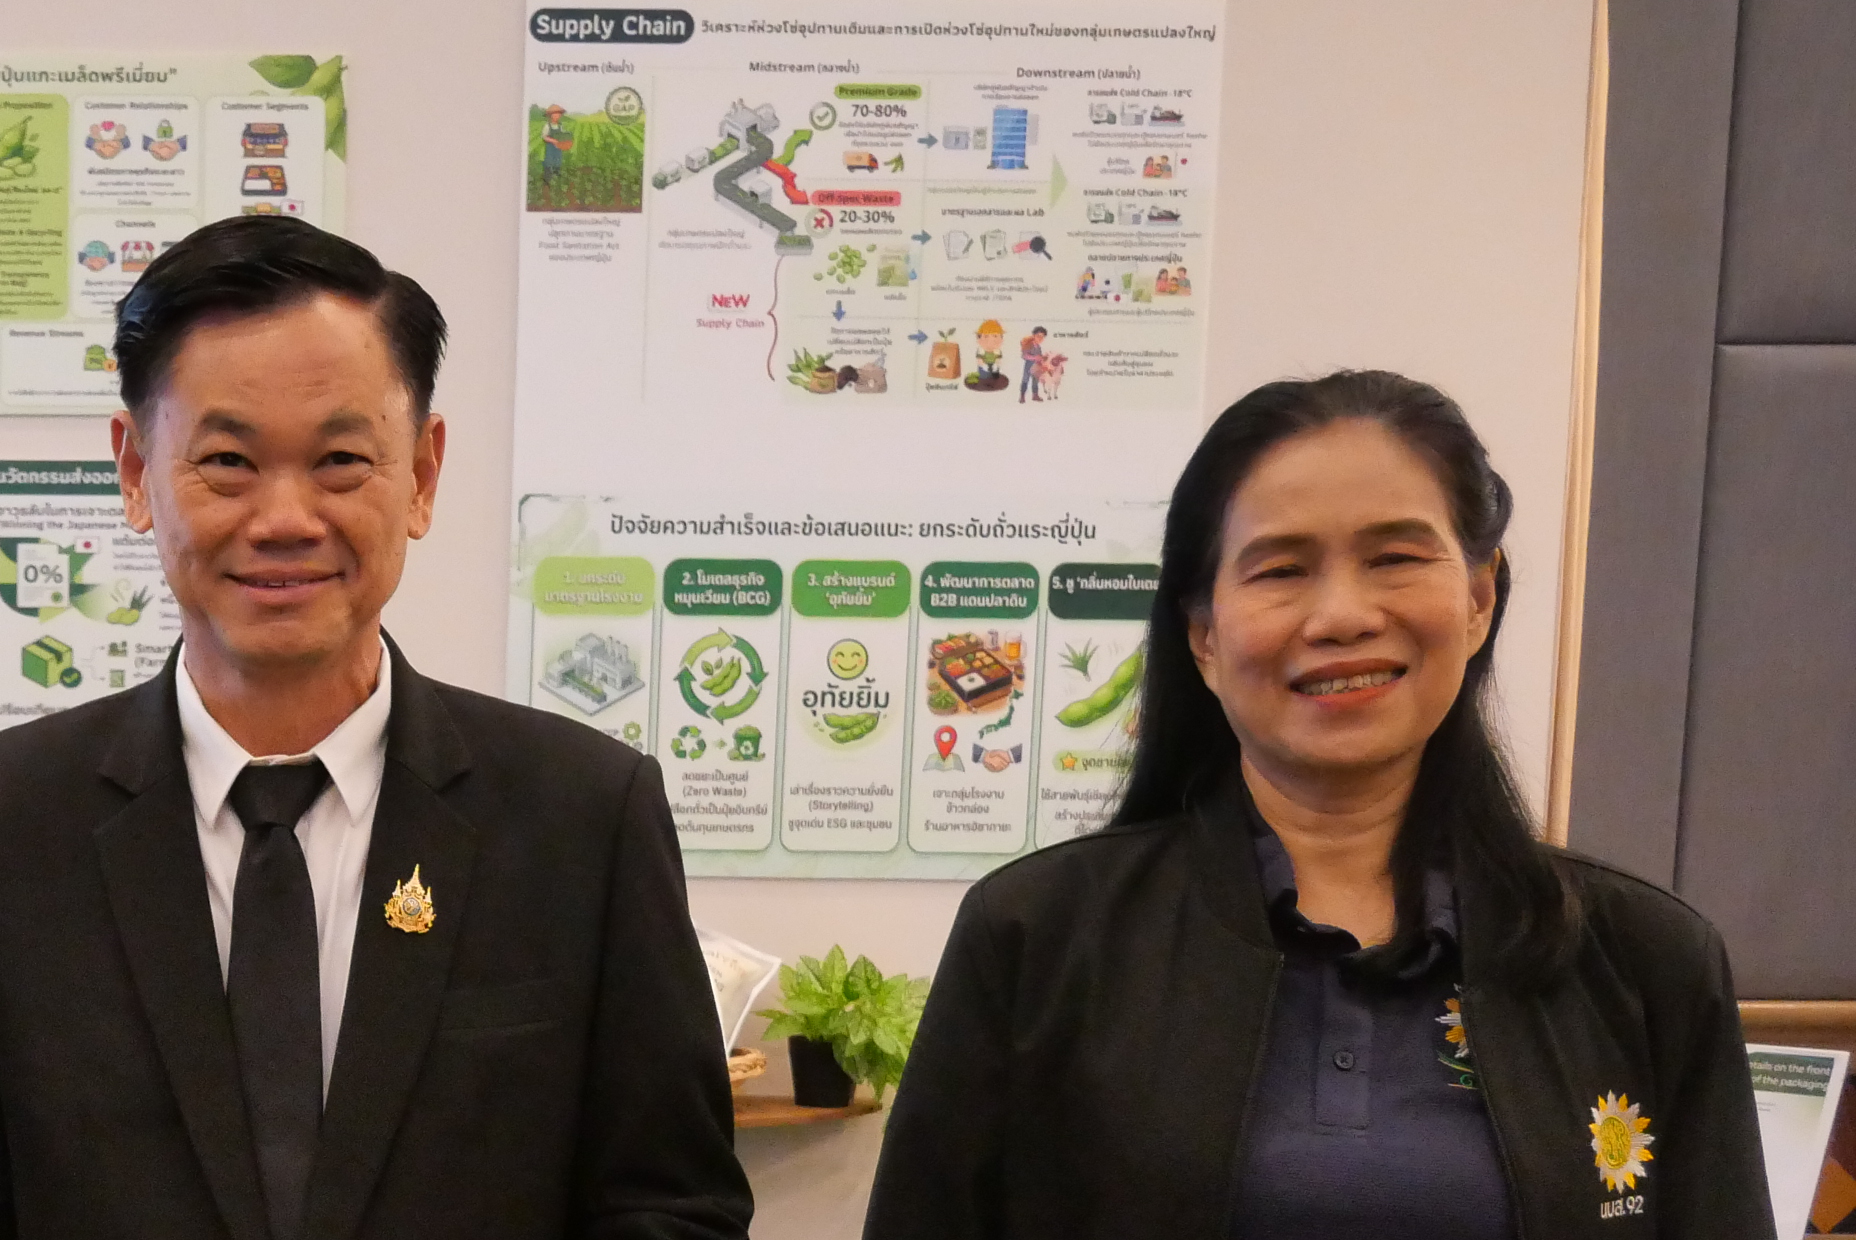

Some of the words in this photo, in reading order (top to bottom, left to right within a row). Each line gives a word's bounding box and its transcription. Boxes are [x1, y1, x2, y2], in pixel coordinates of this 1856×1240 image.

[536, 15, 615, 40] Supply
[623, 16, 687, 36] Chain
[538, 61, 599, 75] Upstream
[748, 61, 815, 73] Midstream
[1016, 67, 1095, 80] Downstream
[852, 104, 908, 118] 70-80%
[839, 210, 895, 223] 20-30%
[711, 294, 750, 309] NEW
[735, 318, 765, 328] Chain
[610, 512, 913, 538] ปัจจัยความสำเร็จและข้อเสนอแนะ:
[919, 511, 1097, 546] ยกระดับถั่วแระญี่ปุ่น
[23, 564, 64, 584] 0%
[682, 572, 694, 585] 2.
[808, 573, 820, 586] 3.
[924, 575, 937, 587] 4.
[1052, 575, 1063, 590] 5.
[732, 591, 771, 606] (BCG)
[930, 592, 957, 607] B2B
[802, 677, 890, 717] อุทัยยิ้ม
[682, 786, 710, 799] (Zero
[712, 786, 747, 799] Waste)
[807, 799, 874, 813] (Storytelling)
[826, 818, 847, 829] ESG
[1749, 1061, 1773, 1071] etails
[1788, 1063, 1805, 1074] the
[1806, 1064, 1831, 1076] front
